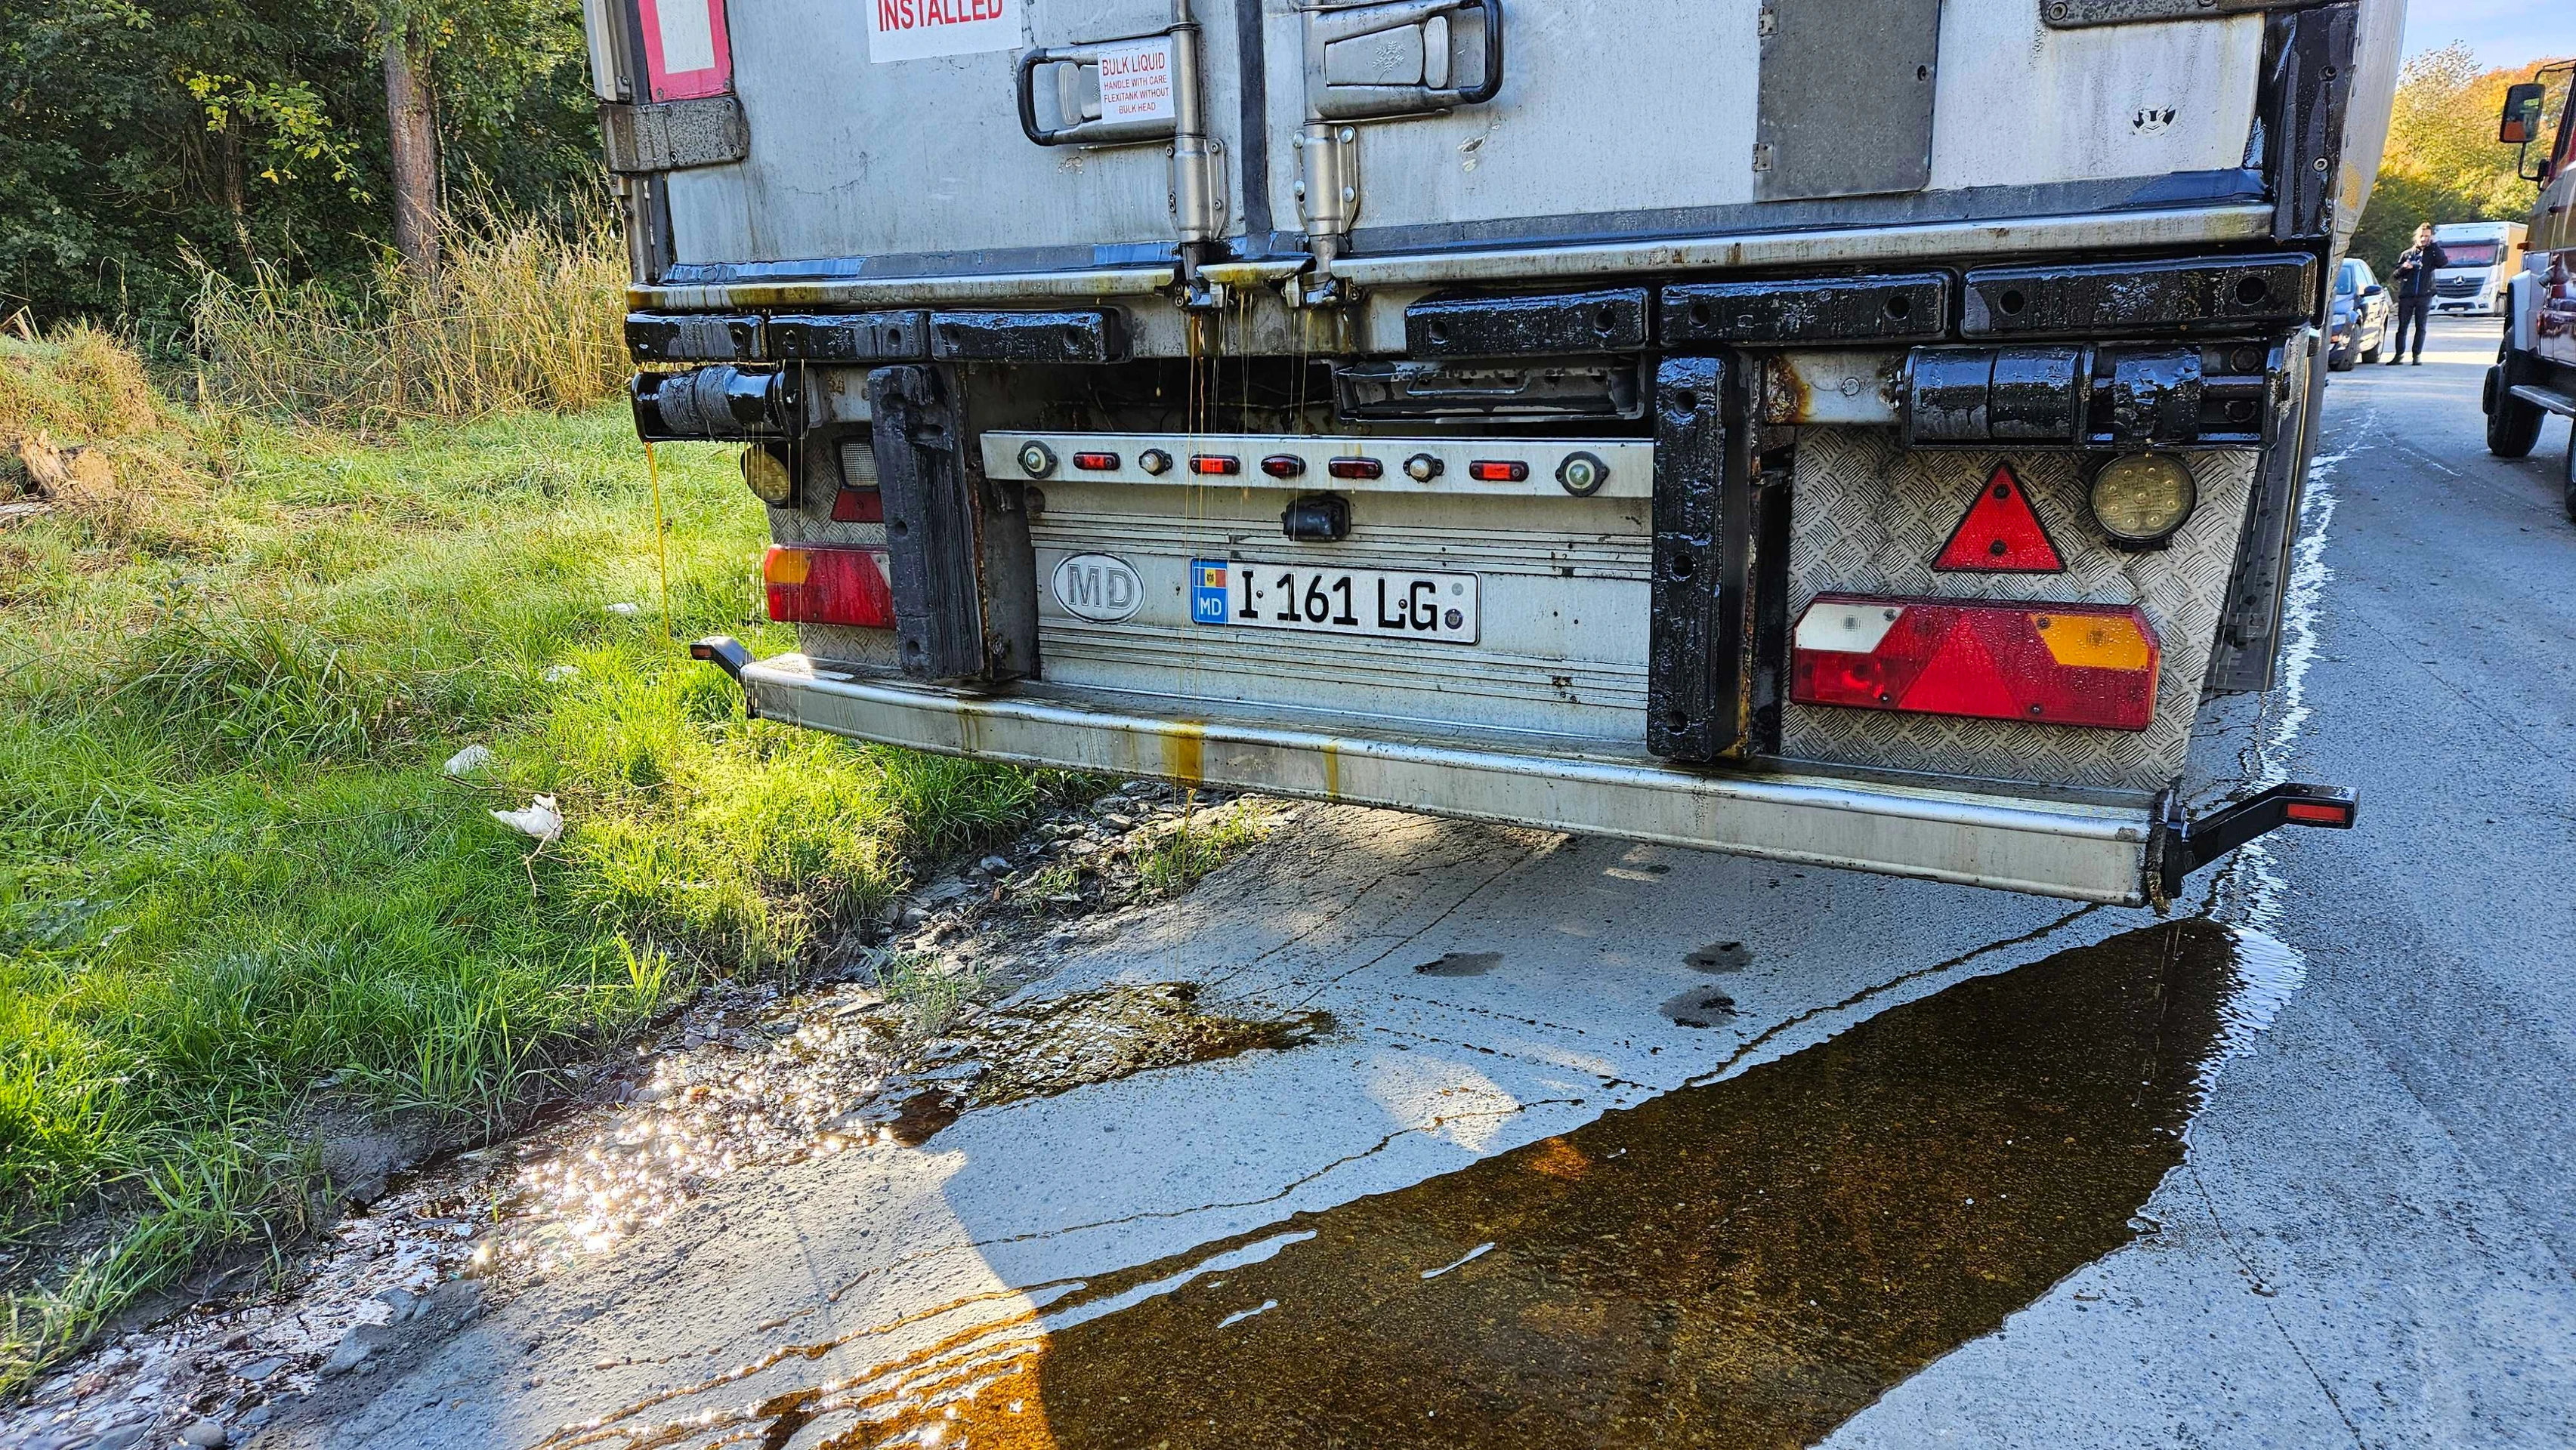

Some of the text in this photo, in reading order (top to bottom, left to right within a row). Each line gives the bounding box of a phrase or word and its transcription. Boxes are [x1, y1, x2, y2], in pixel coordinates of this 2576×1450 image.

[878, 0, 1003, 32] INSTALLED
[1102, 52, 1164, 76] BULK LIQUID
[1104, 74, 1167, 90] HANDLE WITH CARE
[1104, 87, 1169, 103] FLEXITANK WITHOUT
[1119, 102, 1156, 114] BULK HEAD
[1067, 563, 1135, 609] MD
[1200, 597, 1222, 616] MD
[1239, 570, 1438, 631] I 161 LG
